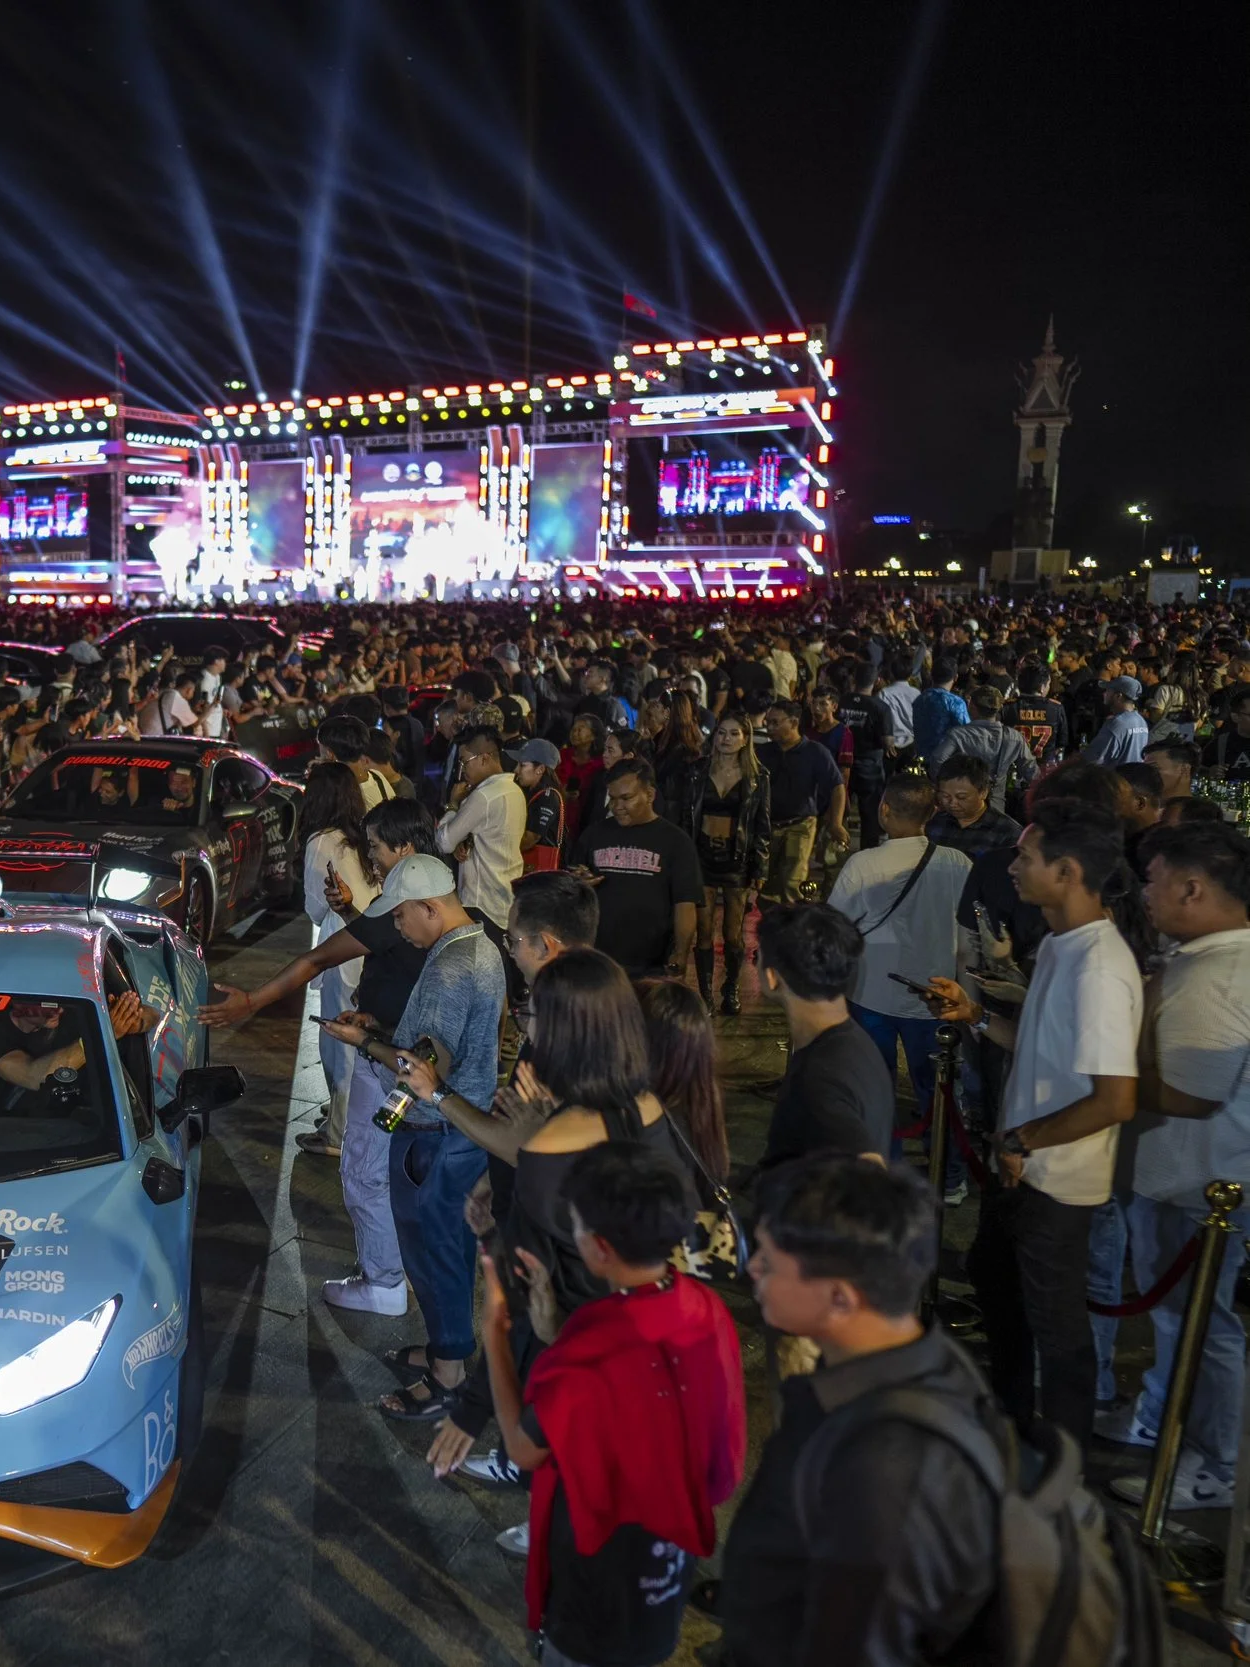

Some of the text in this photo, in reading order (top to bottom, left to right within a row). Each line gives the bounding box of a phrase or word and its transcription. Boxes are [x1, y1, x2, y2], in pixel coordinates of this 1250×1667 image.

[128, 756, 172, 769] 3000
[5, 1270, 65, 1283] MONG
[4, 1281, 65, 1294] GROUP
